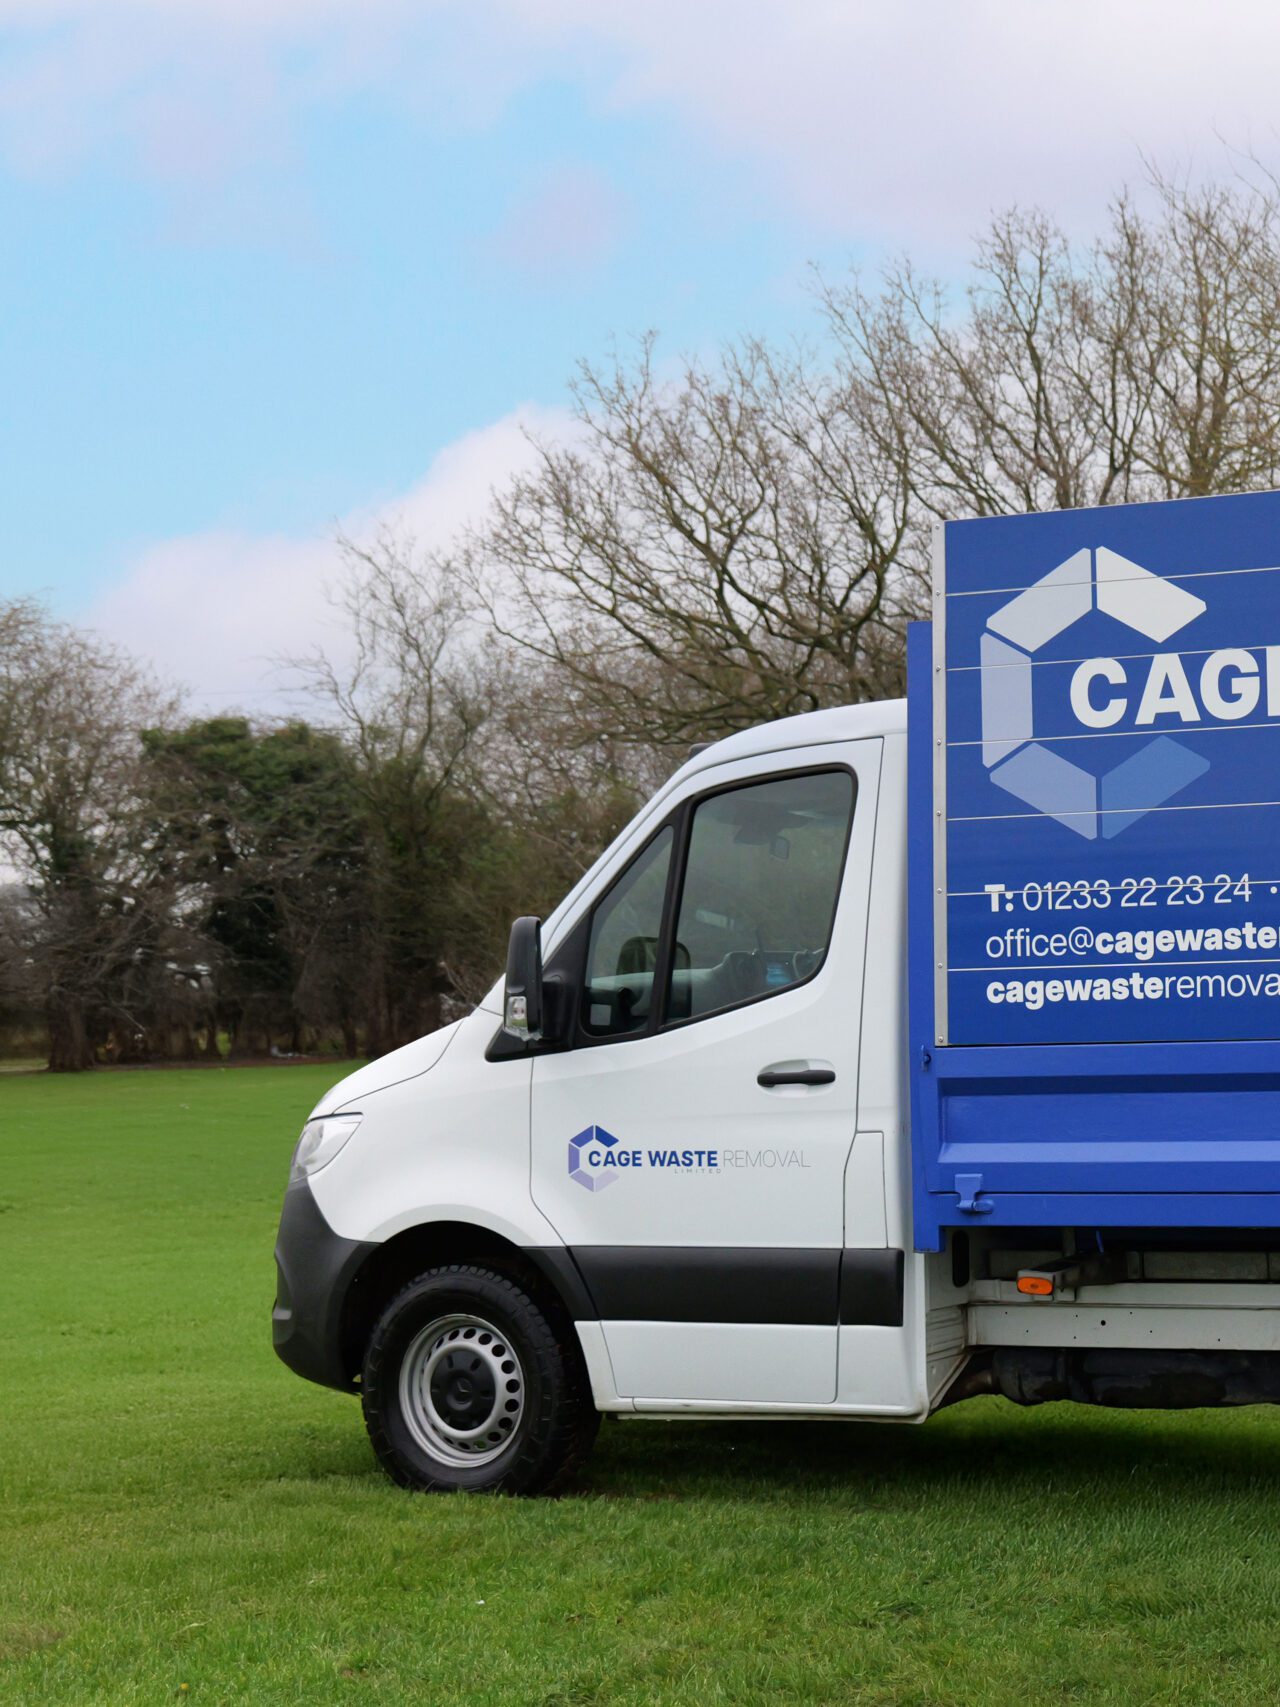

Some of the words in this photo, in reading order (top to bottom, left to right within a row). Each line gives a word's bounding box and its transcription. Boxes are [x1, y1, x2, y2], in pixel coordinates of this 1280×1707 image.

[985, 884, 1015, 914] T:
[1021, 880, 1112, 912] 01233
[1120, 877, 1158, 908] 22
[1166, 875, 1204, 906] 23
[1213, 873, 1253, 904] 24
[588, 1150, 643, 1168] CAGE
[647, 1150, 718, 1168] WASTE
[723, 1149, 812, 1169] REMOVAL
[673, 1167, 723, 1175] LIMITED
